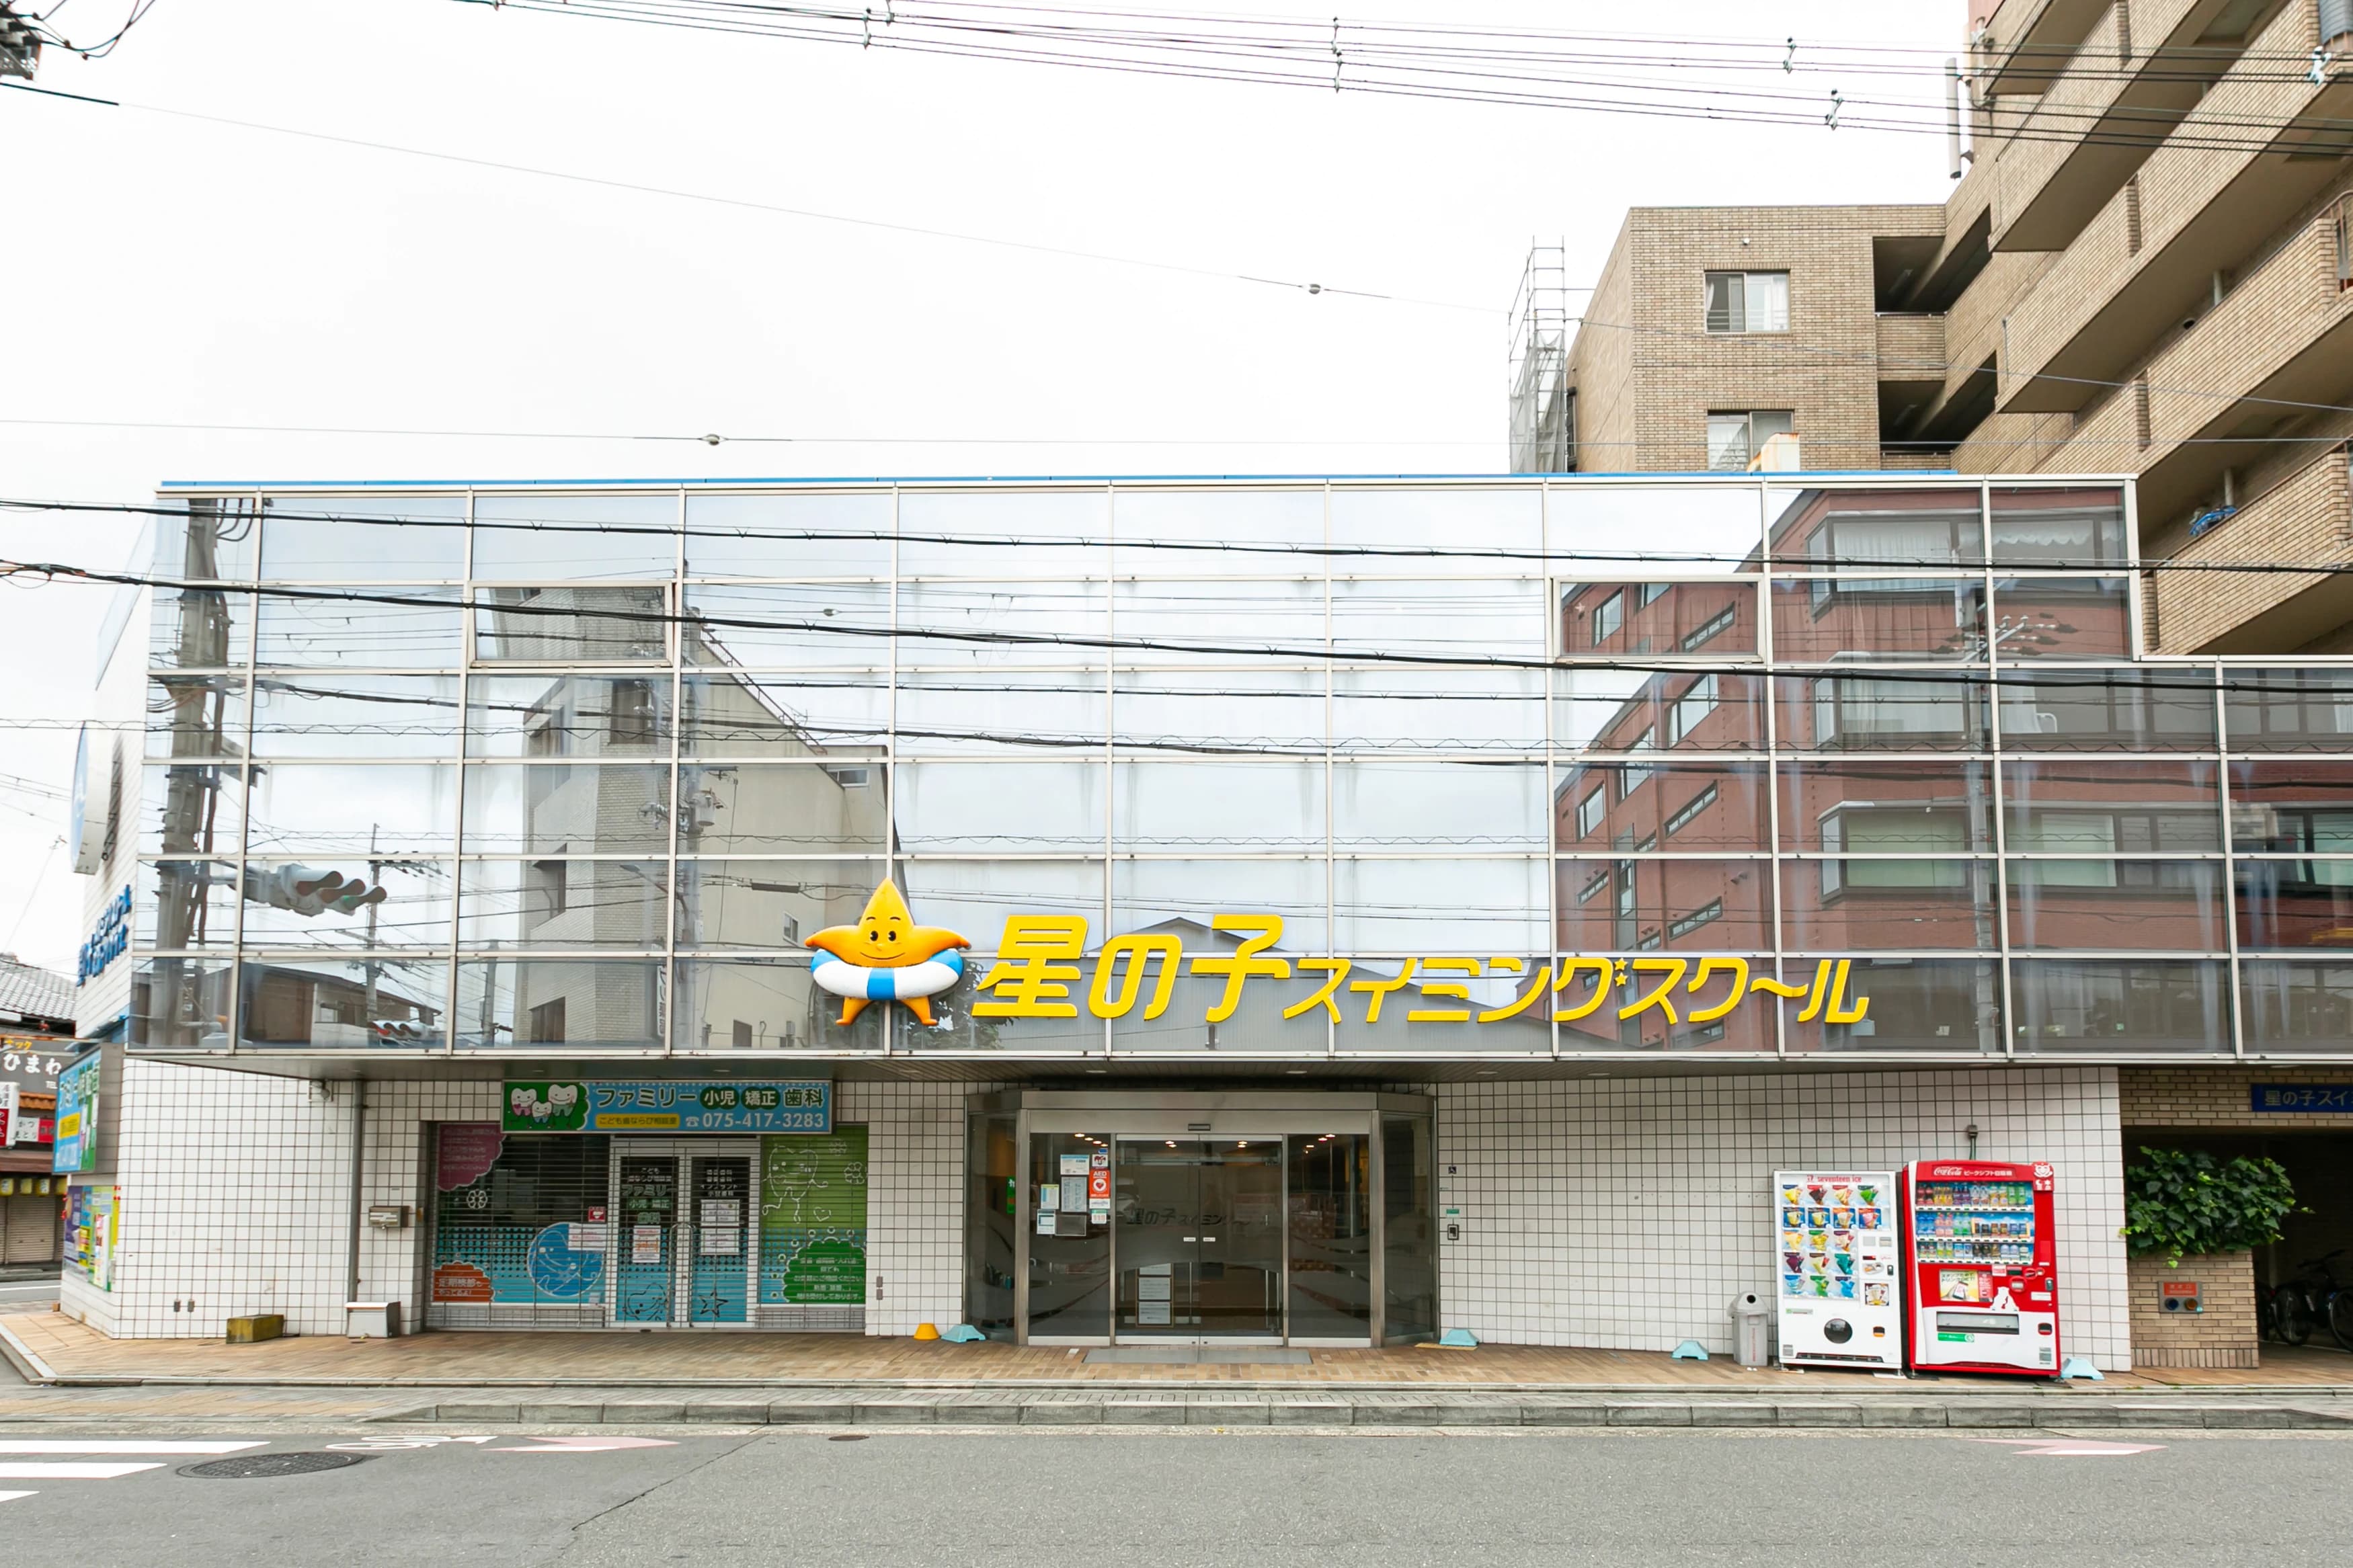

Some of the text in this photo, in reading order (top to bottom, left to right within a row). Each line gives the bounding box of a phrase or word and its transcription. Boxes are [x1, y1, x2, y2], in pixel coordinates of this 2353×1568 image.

[2264, 1089, 2353, 1106] 星の子スイ
[703, 1113, 824, 1128] 075-417-3283
